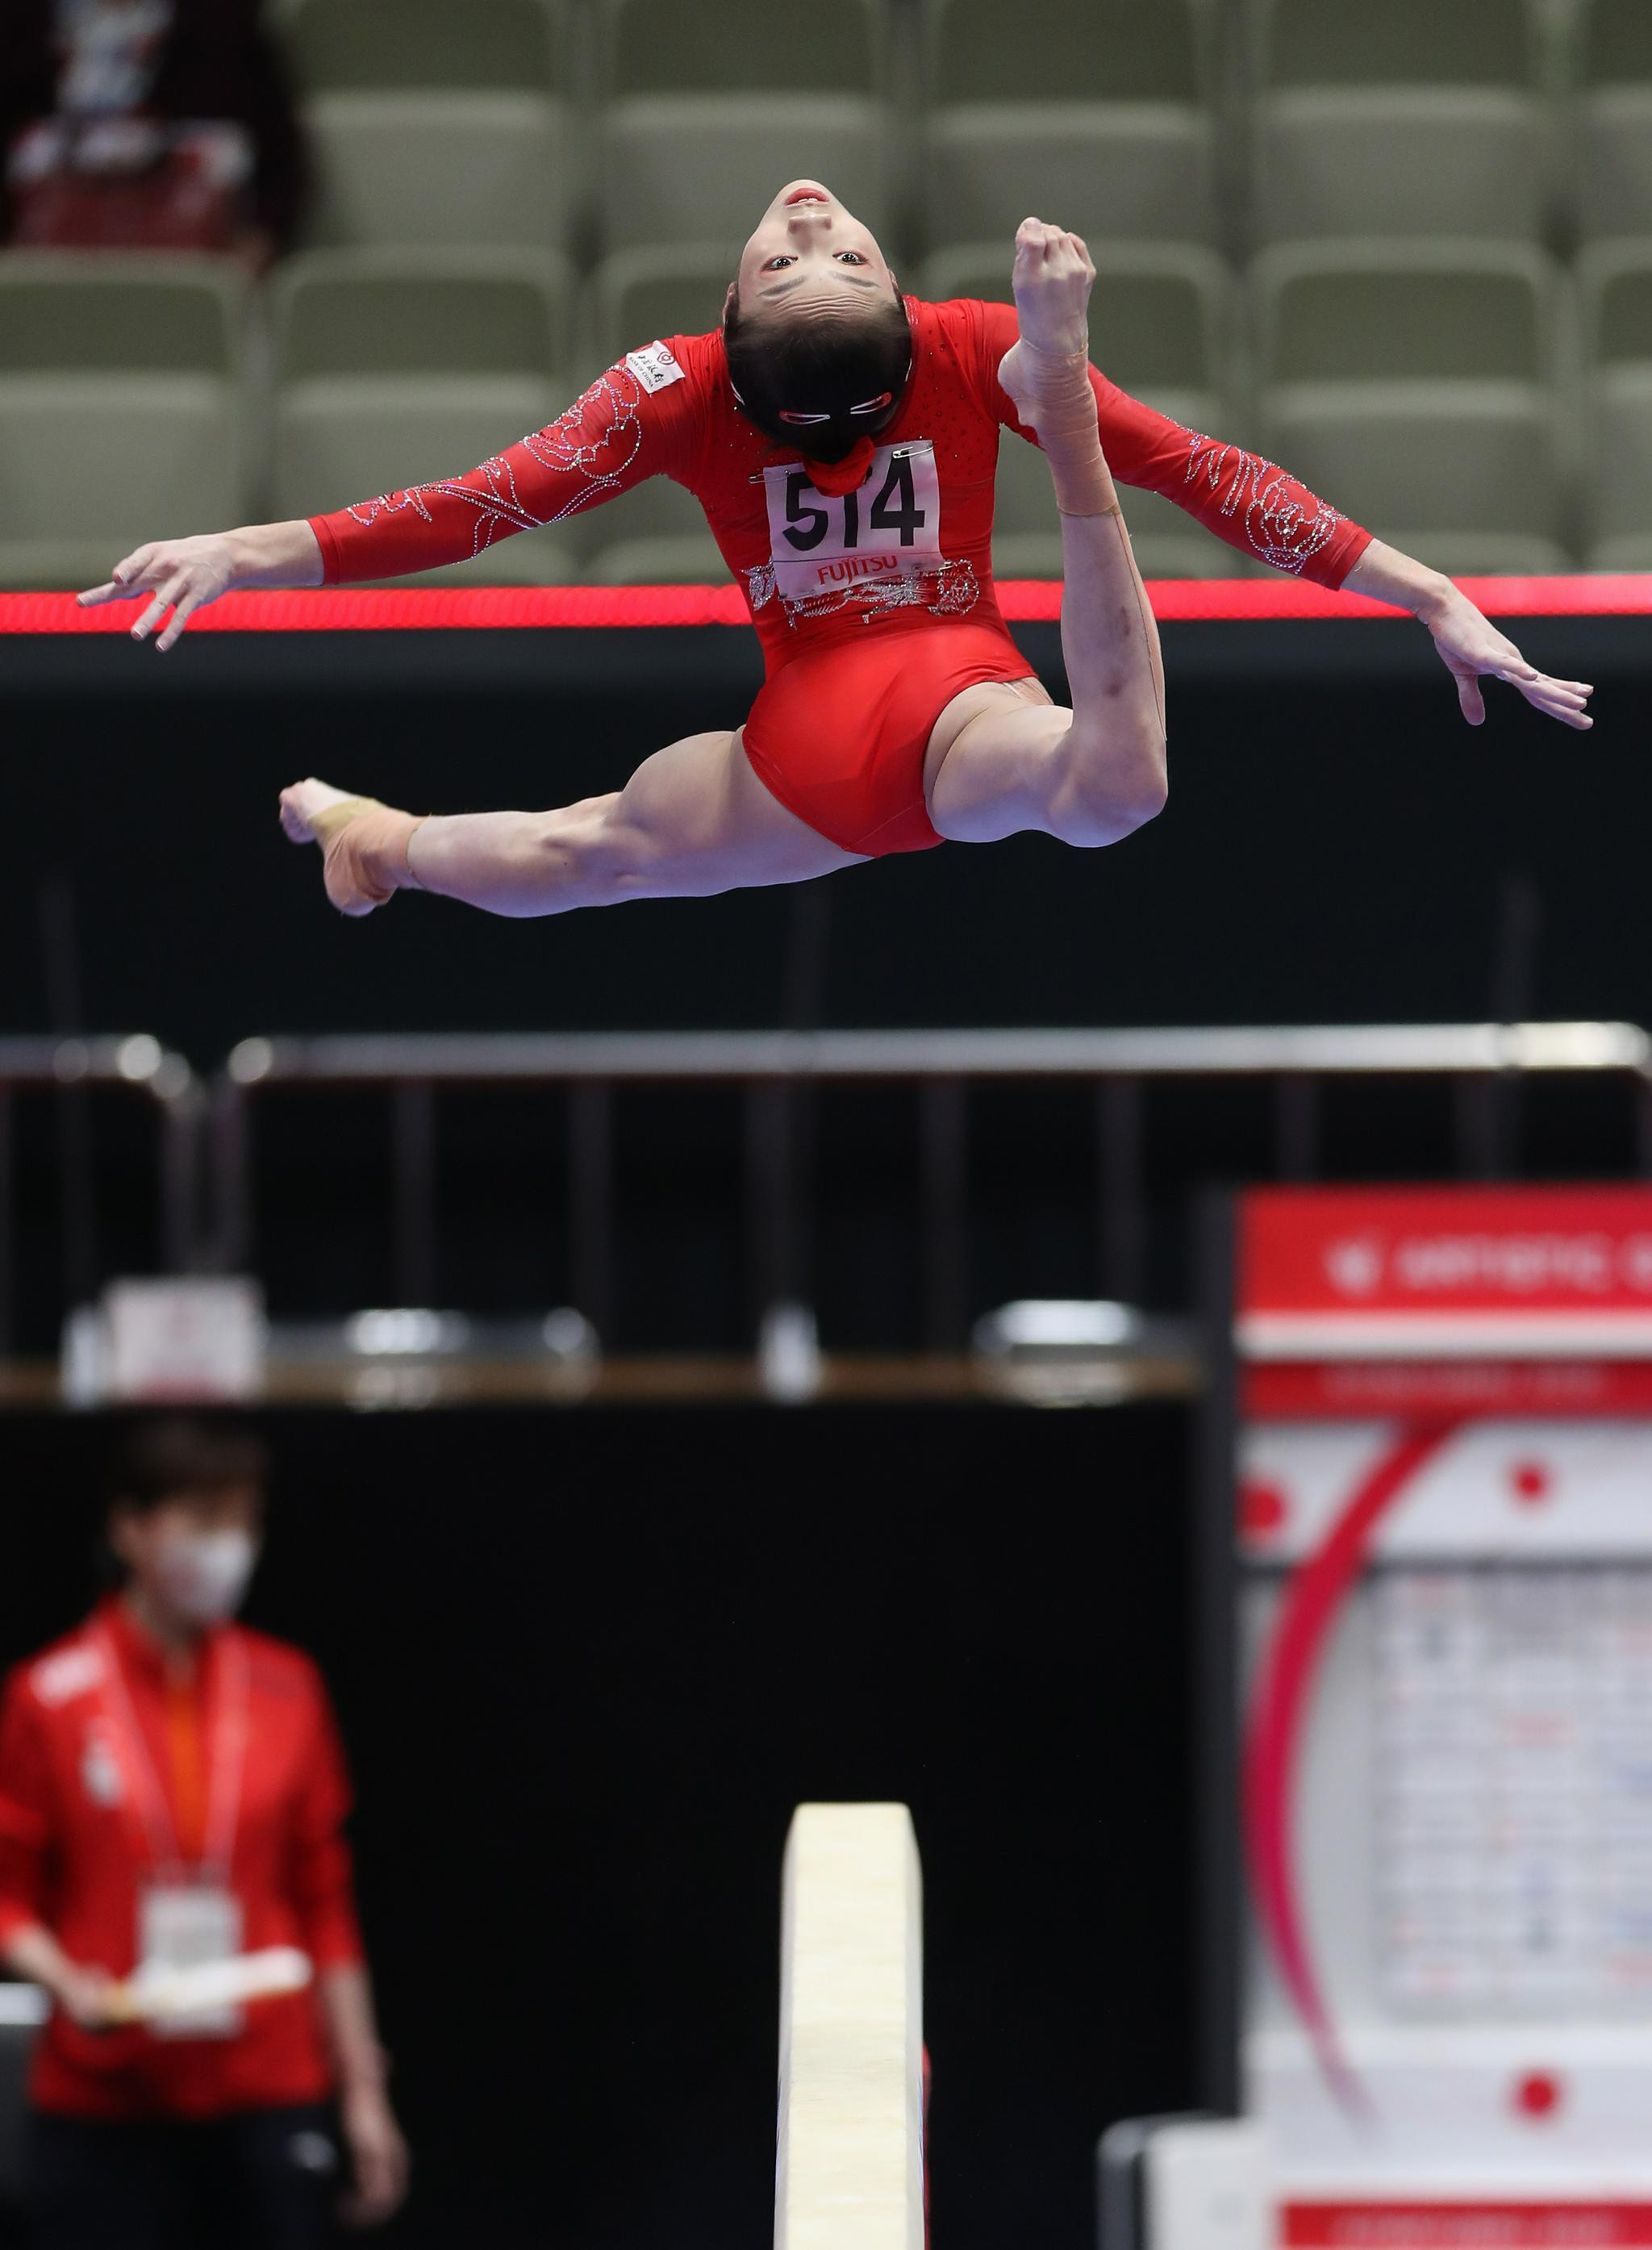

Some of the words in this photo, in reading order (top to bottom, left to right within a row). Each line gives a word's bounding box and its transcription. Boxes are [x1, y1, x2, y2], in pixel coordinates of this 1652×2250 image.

[629, 357, 640, 366] BANK
[642, 371, 654, 387] CHINA
[782, 451, 925, 551] 514
[816, 555, 898, 586] FUJITSU
